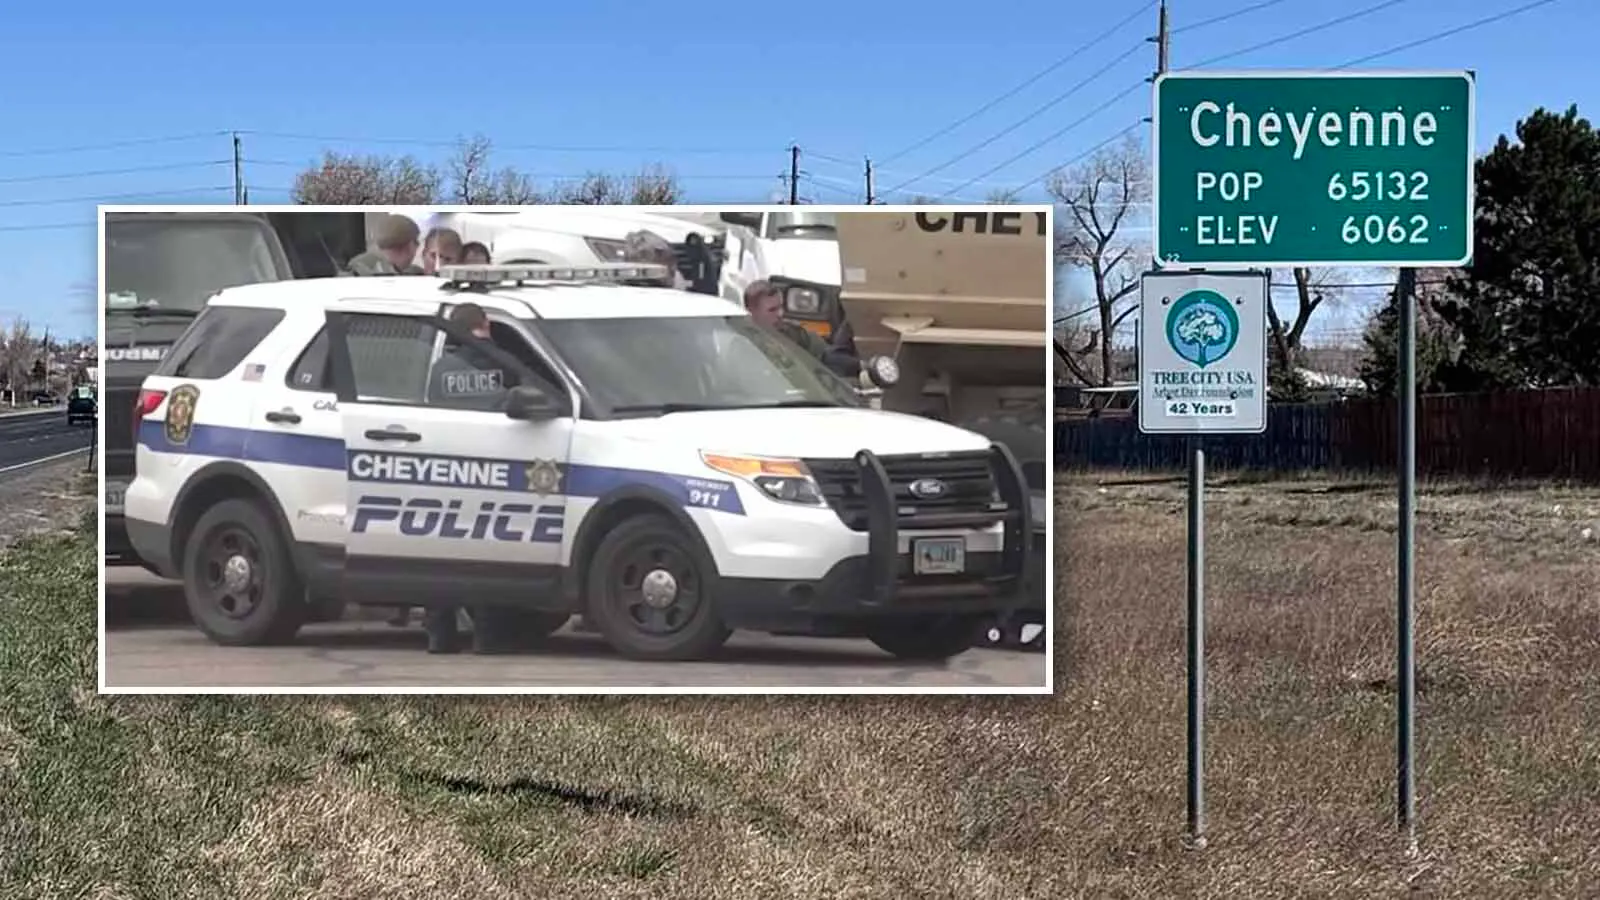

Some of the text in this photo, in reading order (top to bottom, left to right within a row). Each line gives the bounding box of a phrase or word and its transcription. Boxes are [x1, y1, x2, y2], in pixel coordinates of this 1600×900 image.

[1190, 101, 1437, 160] Cheyenne
[1197, 171, 1429, 201] POP 65132
[1197, 215, 1429, 244] ELEV 6062
[447, 373, 498, 393] POLICE
[1152, 371, 1254, 385] TREE CITY USA
[1169, 402, 1233, 414] 42 Years
[351, 453, 510, 487] CHEYENNE
[690, 489, 720, 507] 911
[352, 495, 566, 543] POLICE
